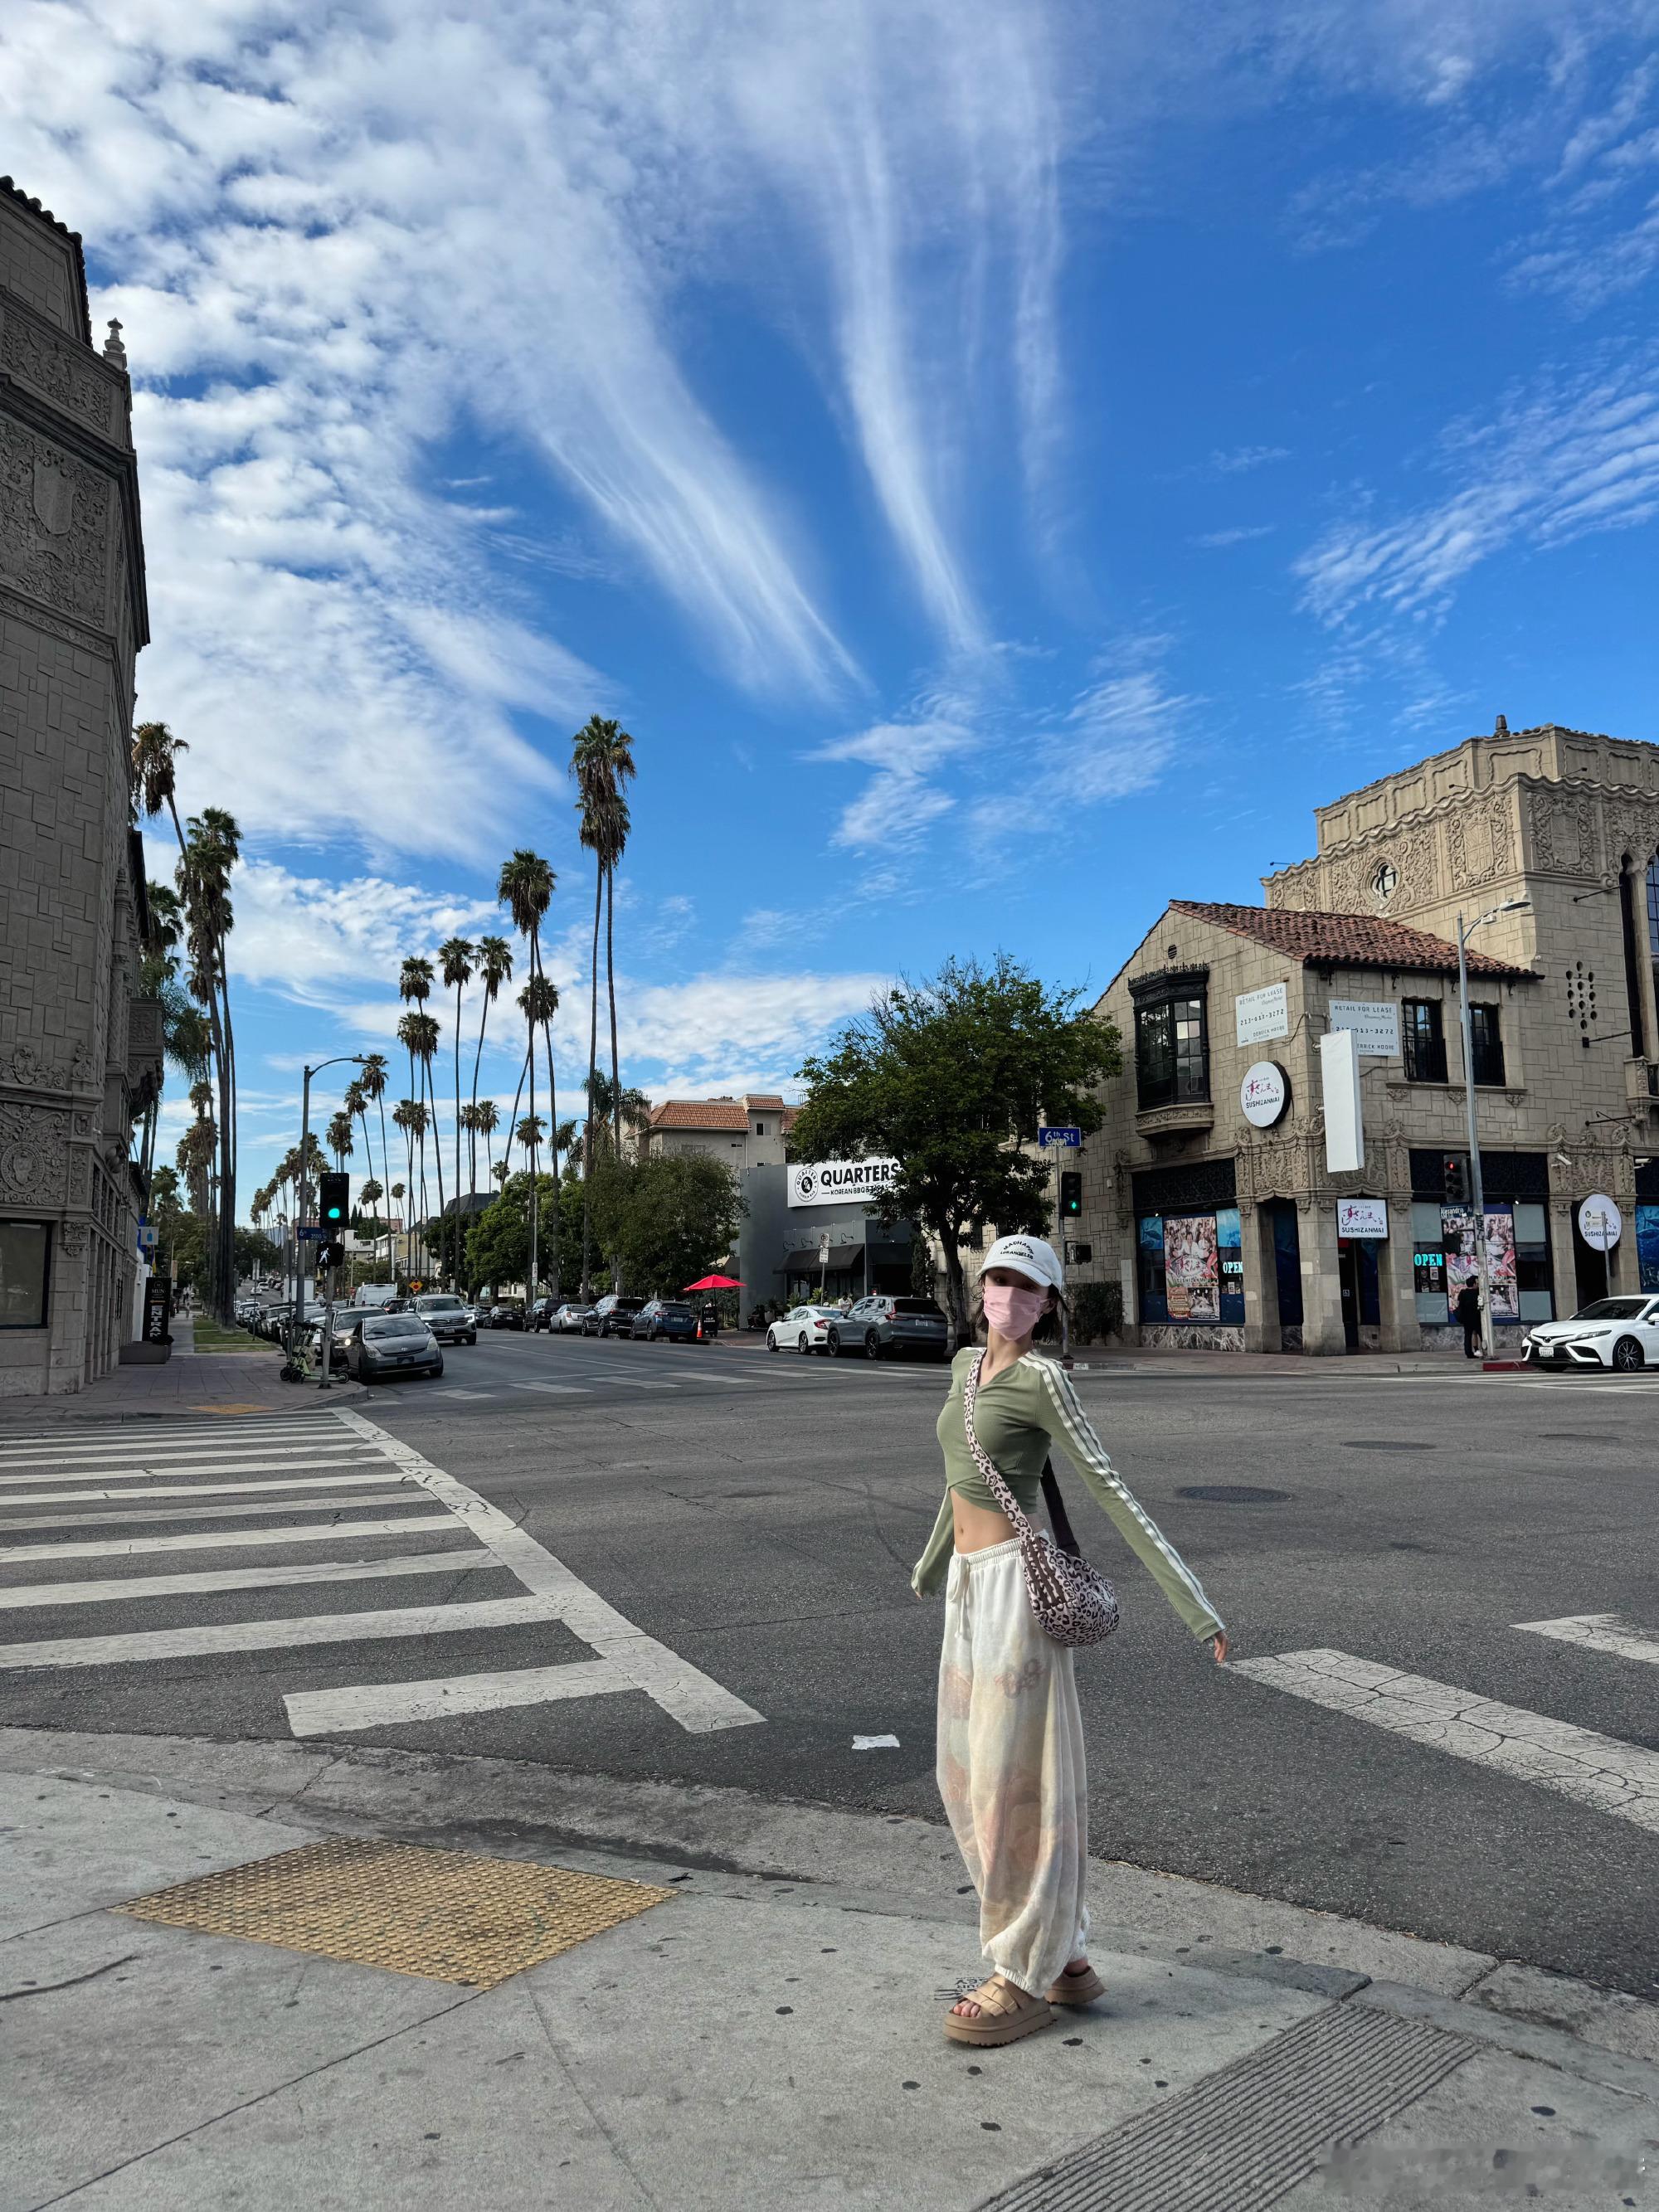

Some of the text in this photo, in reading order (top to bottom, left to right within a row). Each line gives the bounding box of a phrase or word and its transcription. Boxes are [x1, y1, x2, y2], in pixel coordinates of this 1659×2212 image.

[1239, 996, 1255, 1005] RETAIL
[1267, 988, 1283, 997] LEASE
[1246, 1096, 1280, 1108] SUSHIZANMAI
[1045, 1131, 1075, 1143] 6th St
[820, 1163, 898, 1187] QUARTERS
[853, 1186, 865, 1194] BBQ
[1413, 1253, 1443, 1266] OPEN
[1223, 1261, 1243, 1274] OPEN
[149, 1305, 163, 1338] ENTRAN
